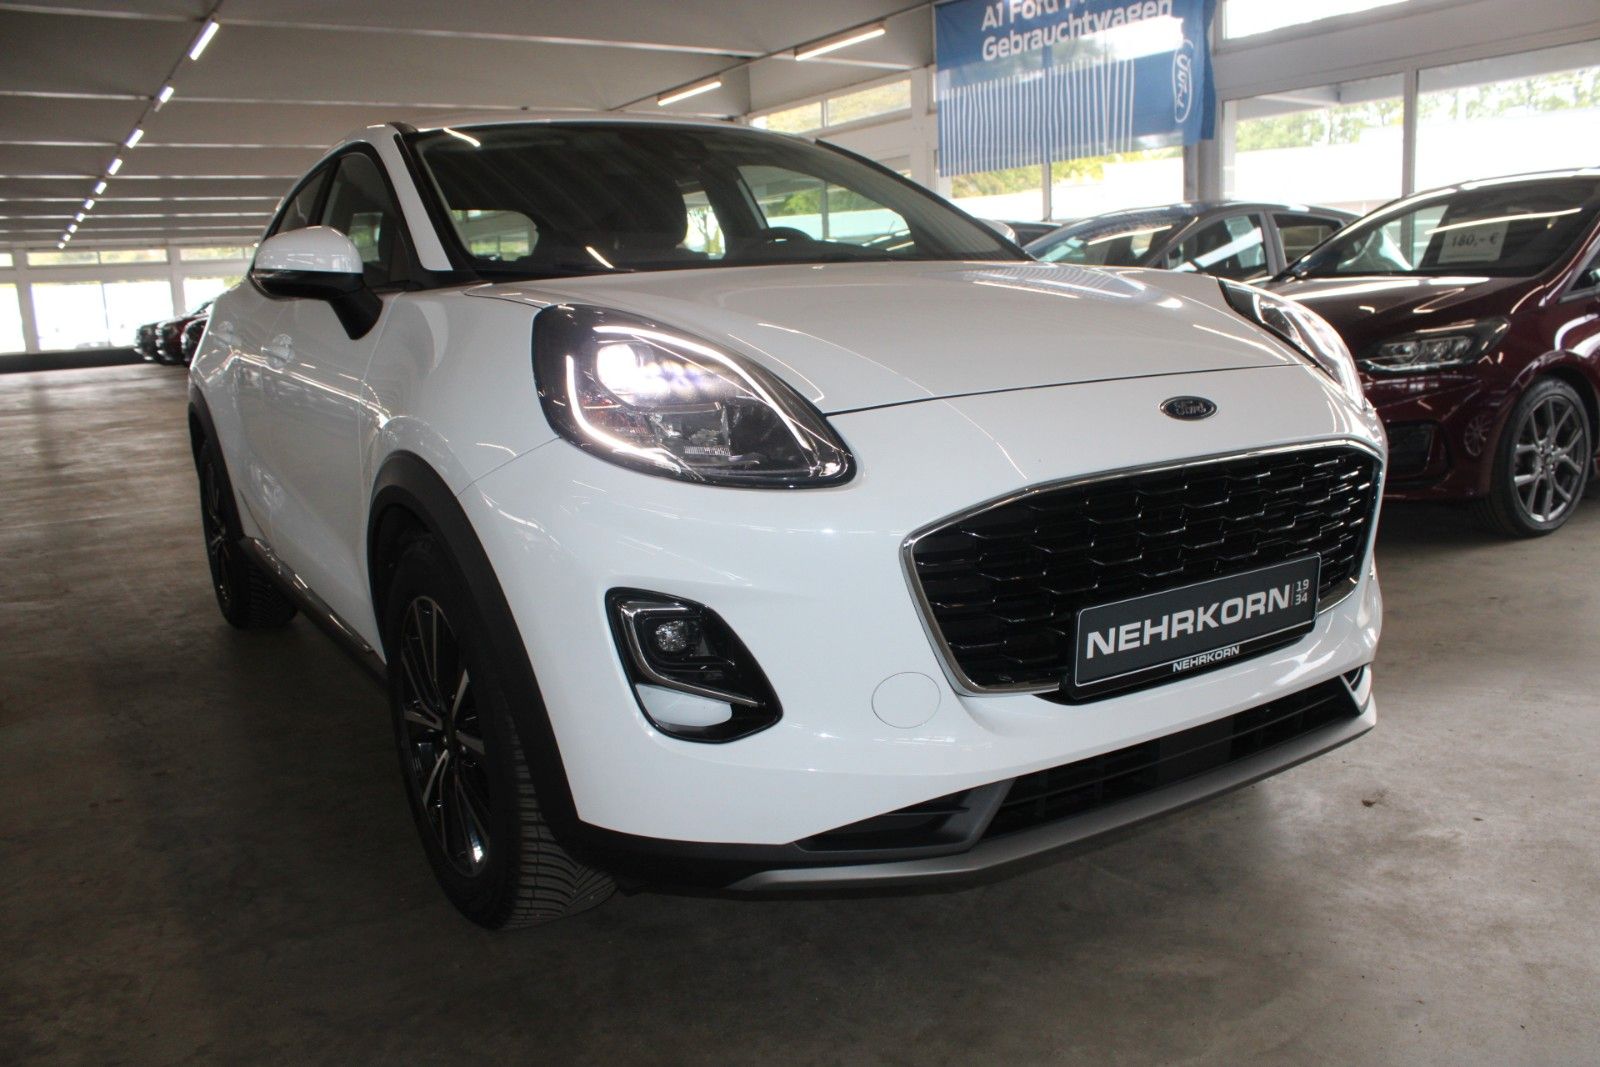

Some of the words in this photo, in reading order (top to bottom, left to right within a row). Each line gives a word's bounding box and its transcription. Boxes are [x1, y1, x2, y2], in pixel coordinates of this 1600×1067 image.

[982, 0, 1172, 61] Gebrauchtwagen
[1295, 592, 1308, 605] 34
[1296, 579, 1310, 591] 19
[1086, 584, 1291, 659] NEHRKORN
[1172, 645, 1240, 673] NEHRKORN
